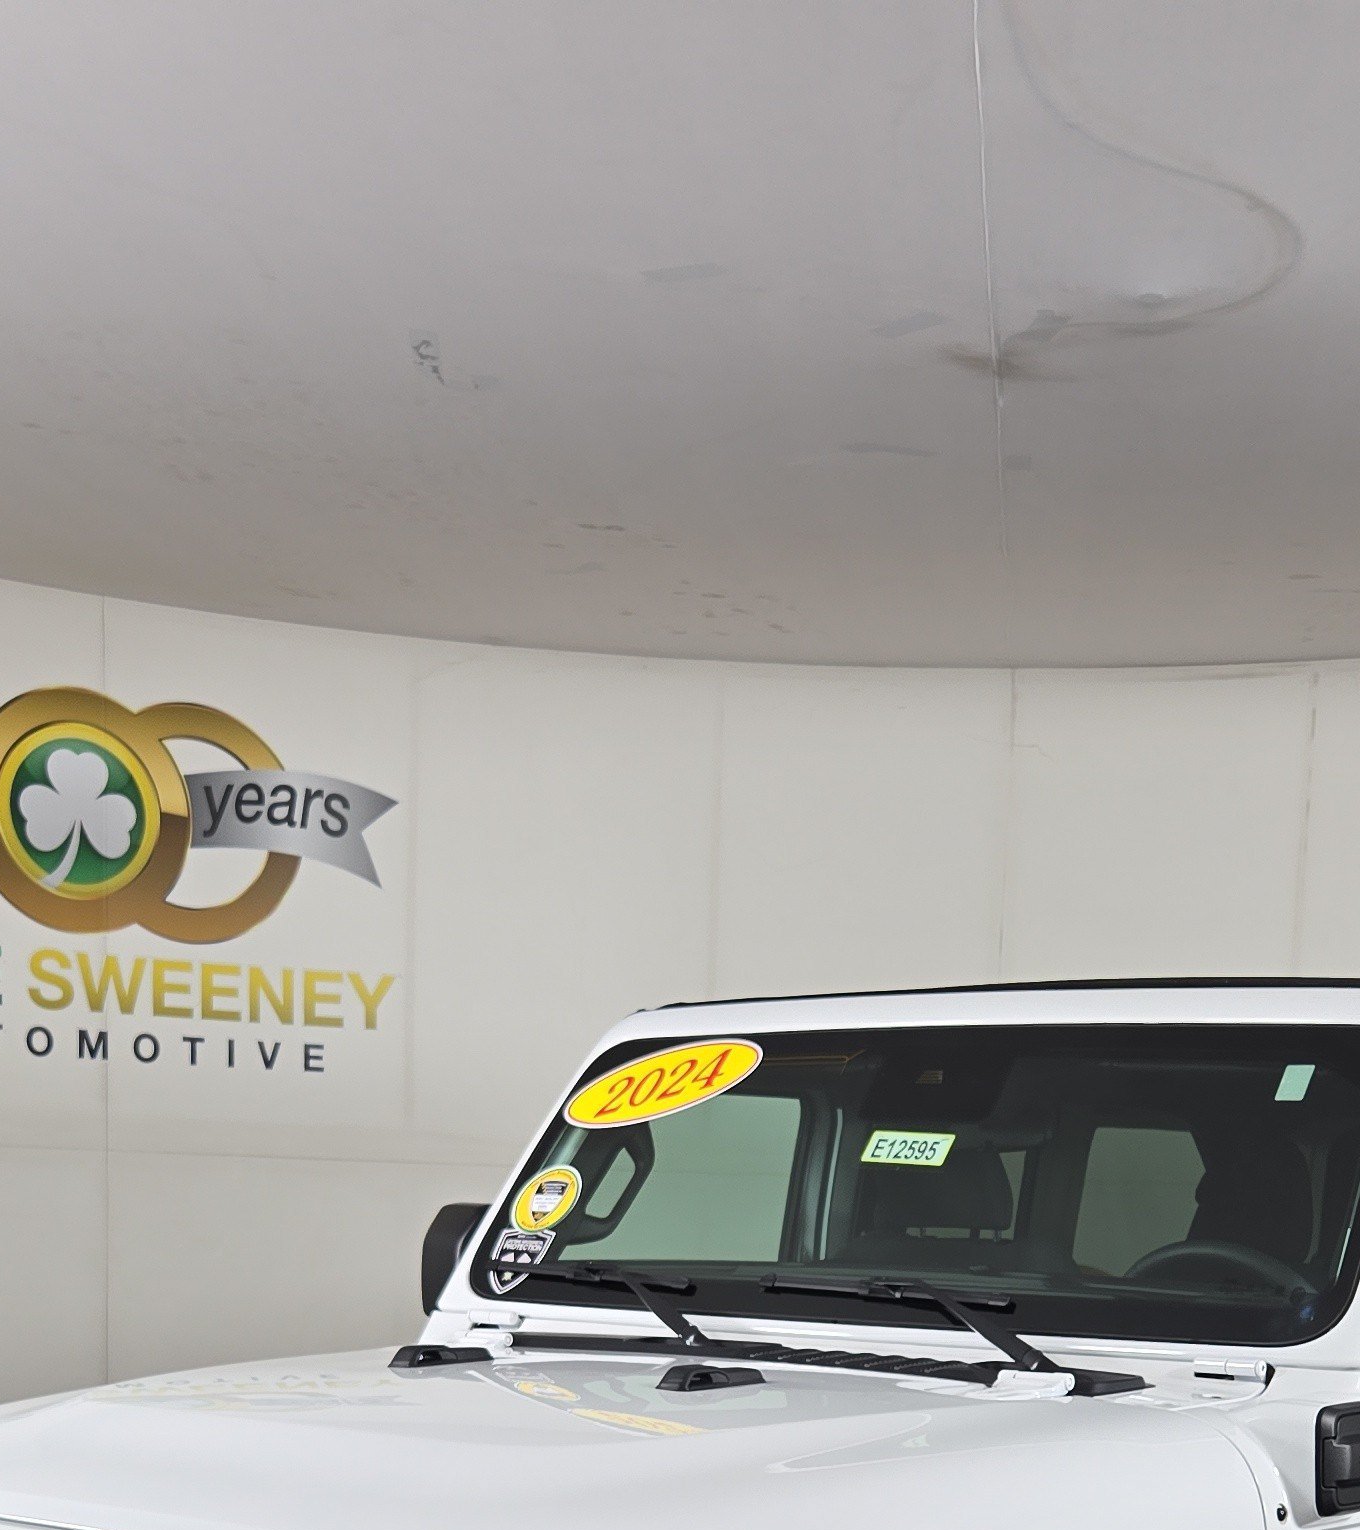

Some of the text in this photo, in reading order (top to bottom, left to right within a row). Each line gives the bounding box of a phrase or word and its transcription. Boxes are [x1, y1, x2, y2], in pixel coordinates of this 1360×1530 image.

[202, 780, 351, 838] years
[28, 950, 394, 1031] SWEENEY
[594, 1049, 733, 1119] 2024
[870, 1138, 940, 1162] E12595
